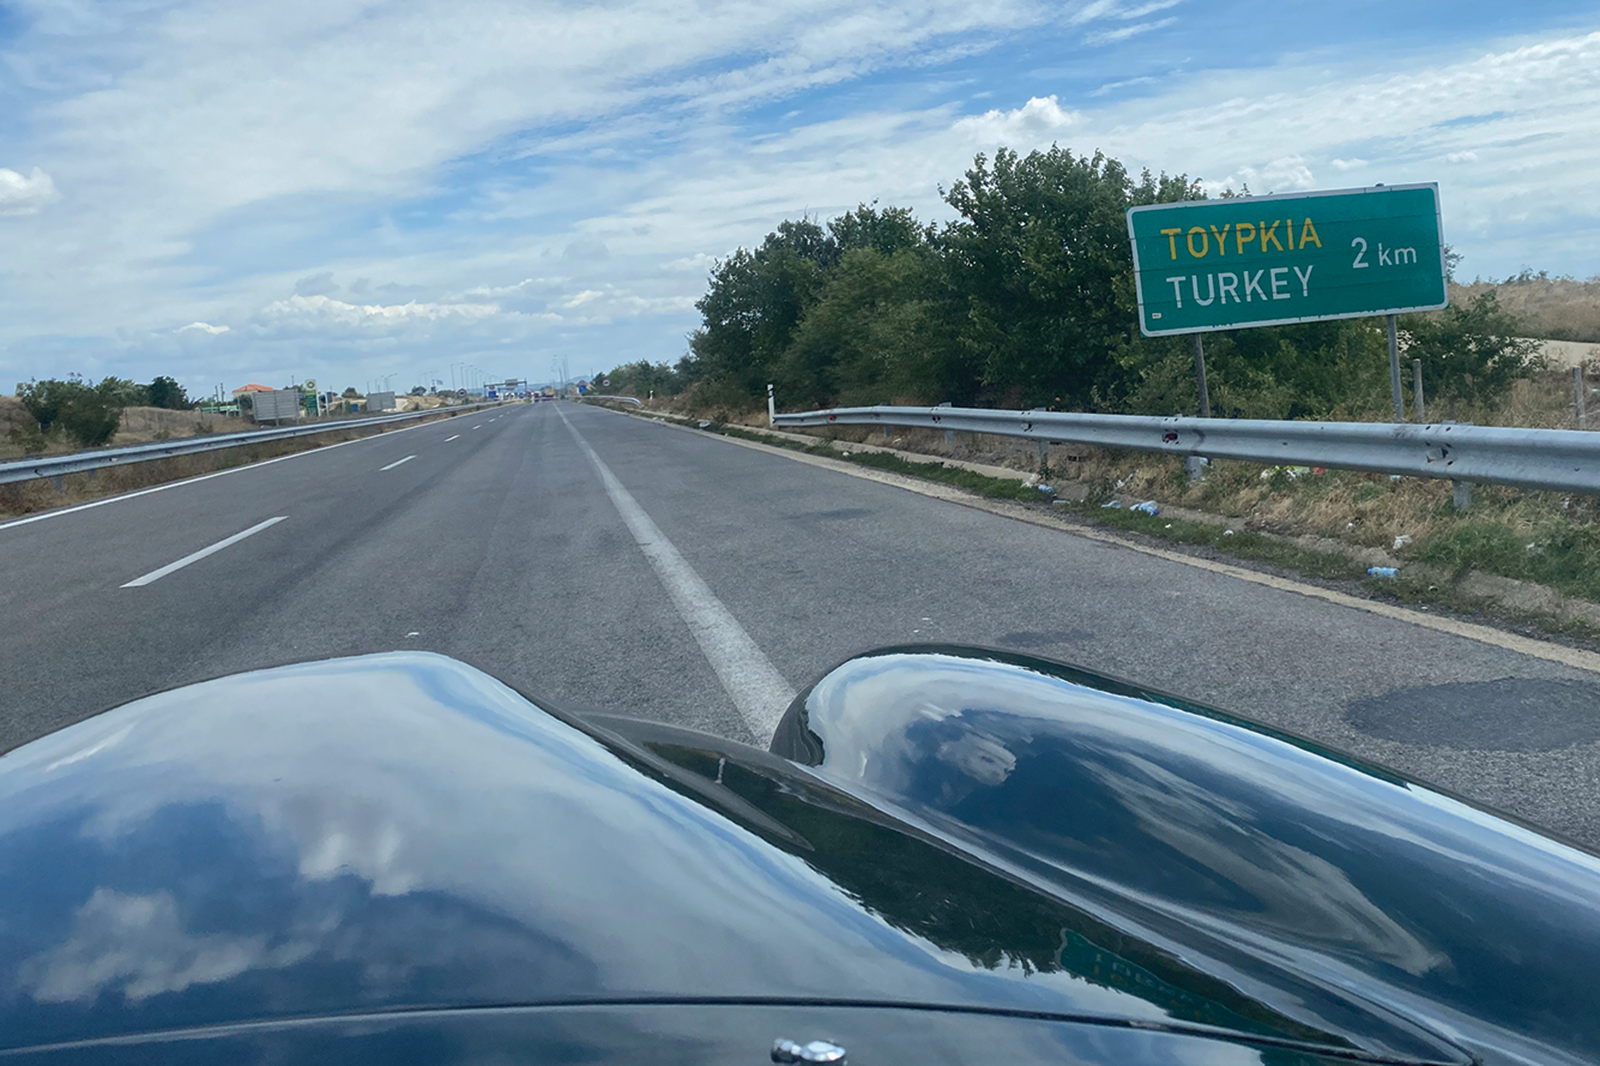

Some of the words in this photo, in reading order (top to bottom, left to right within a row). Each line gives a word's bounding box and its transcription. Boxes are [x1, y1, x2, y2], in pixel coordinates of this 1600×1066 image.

[1160, 217, 1322, 260] ΤΟΥΡΚΙΑ
[1351, 237, 1369, 269] 2
[1378, 243, 1417, 266] km
[1166, 265, 1313, 308] TURKEY
